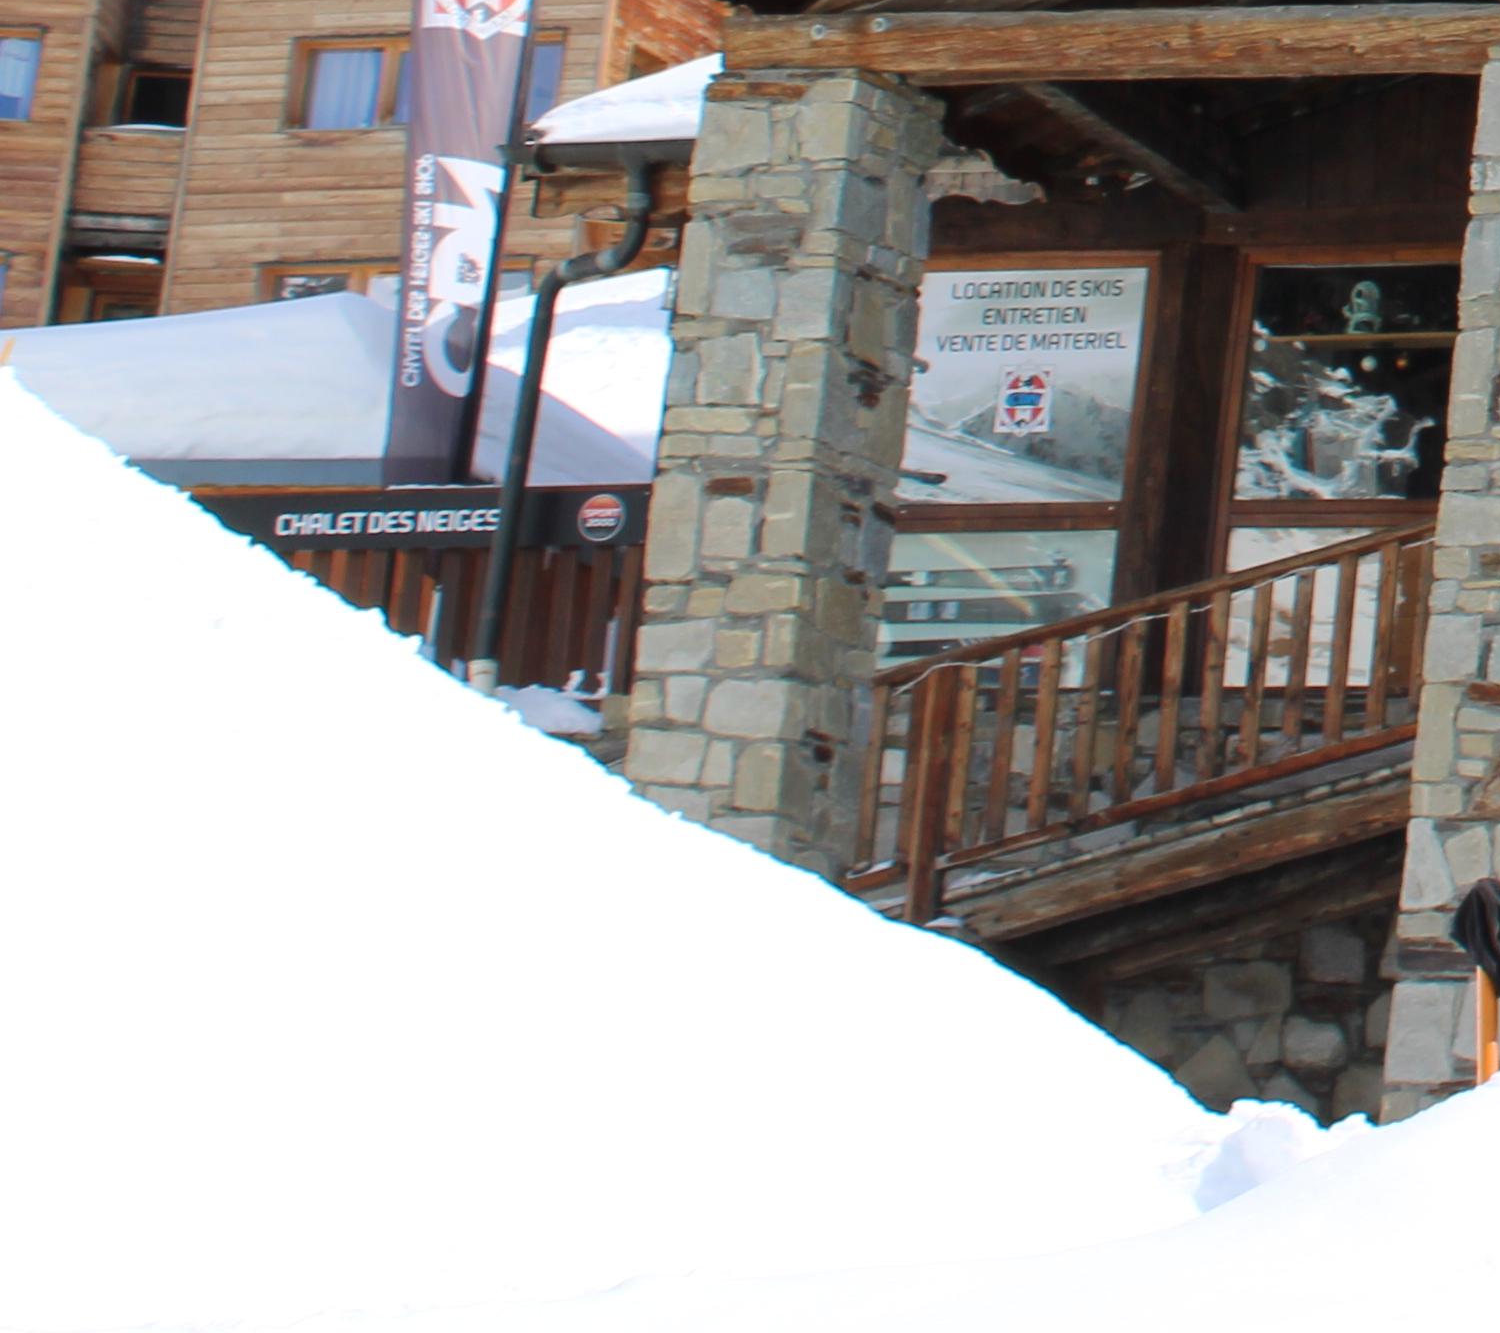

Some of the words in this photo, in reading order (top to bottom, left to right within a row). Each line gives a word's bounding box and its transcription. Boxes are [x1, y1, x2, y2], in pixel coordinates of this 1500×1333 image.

[951, 279, 1046, 300] LOCATION
[1050, 279, 1076, 298] DE
[1080, 278, 1124, 298] SKIS
[982, 306, 1088, 325] ENTRETIEN
[936, 334, 998, 352] VENTE
[1001, 333, 1027, 351] DE
[1029, 331, 1127, 351] MATERIEL
[274, 511, 368, 536] CHALET
[367, 509, 415, 534] DES
[415, 508, 501, 532] NEIGES
